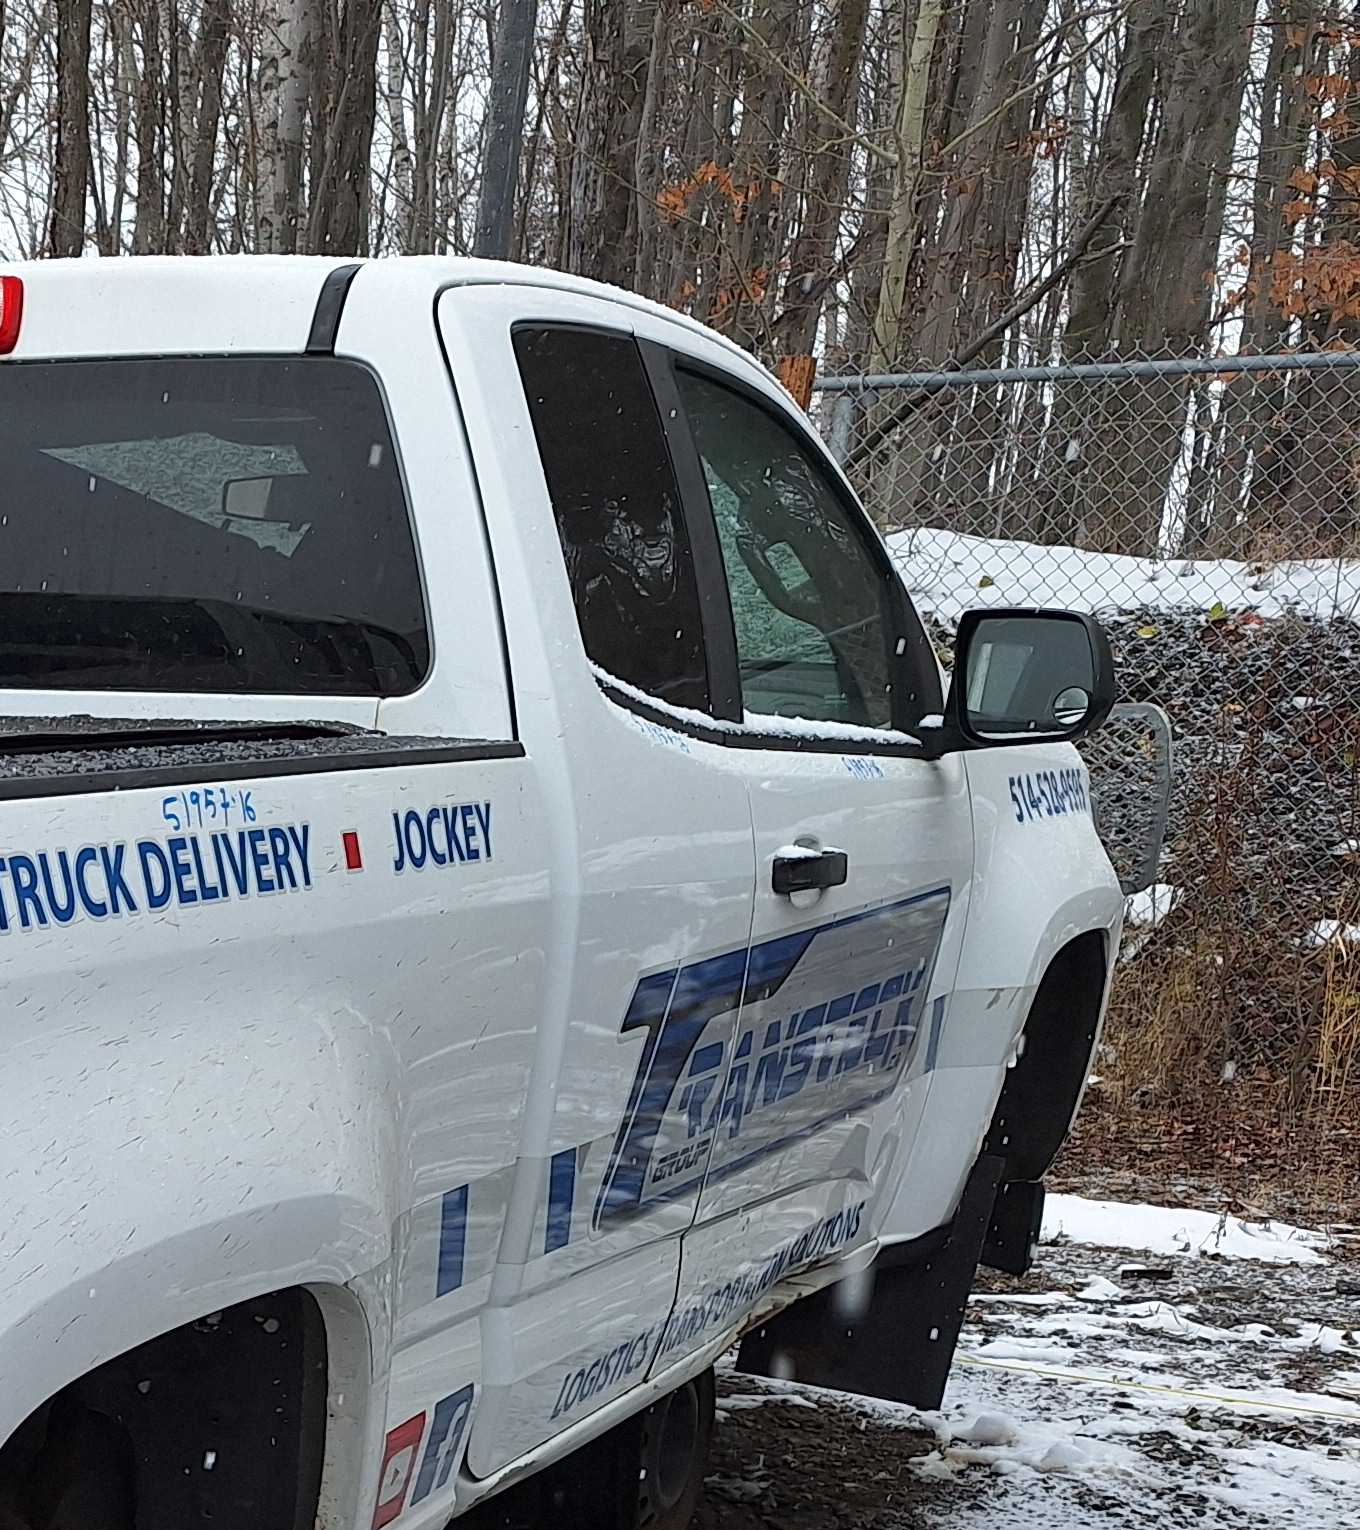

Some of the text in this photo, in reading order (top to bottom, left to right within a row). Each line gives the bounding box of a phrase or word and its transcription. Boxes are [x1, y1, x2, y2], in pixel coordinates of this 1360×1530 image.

[138, 824, 312, 908] DELIVERY
[392, 803, 492, 873] JOCKEY
[549, 1324, 652, 1424] LOGISTICS
